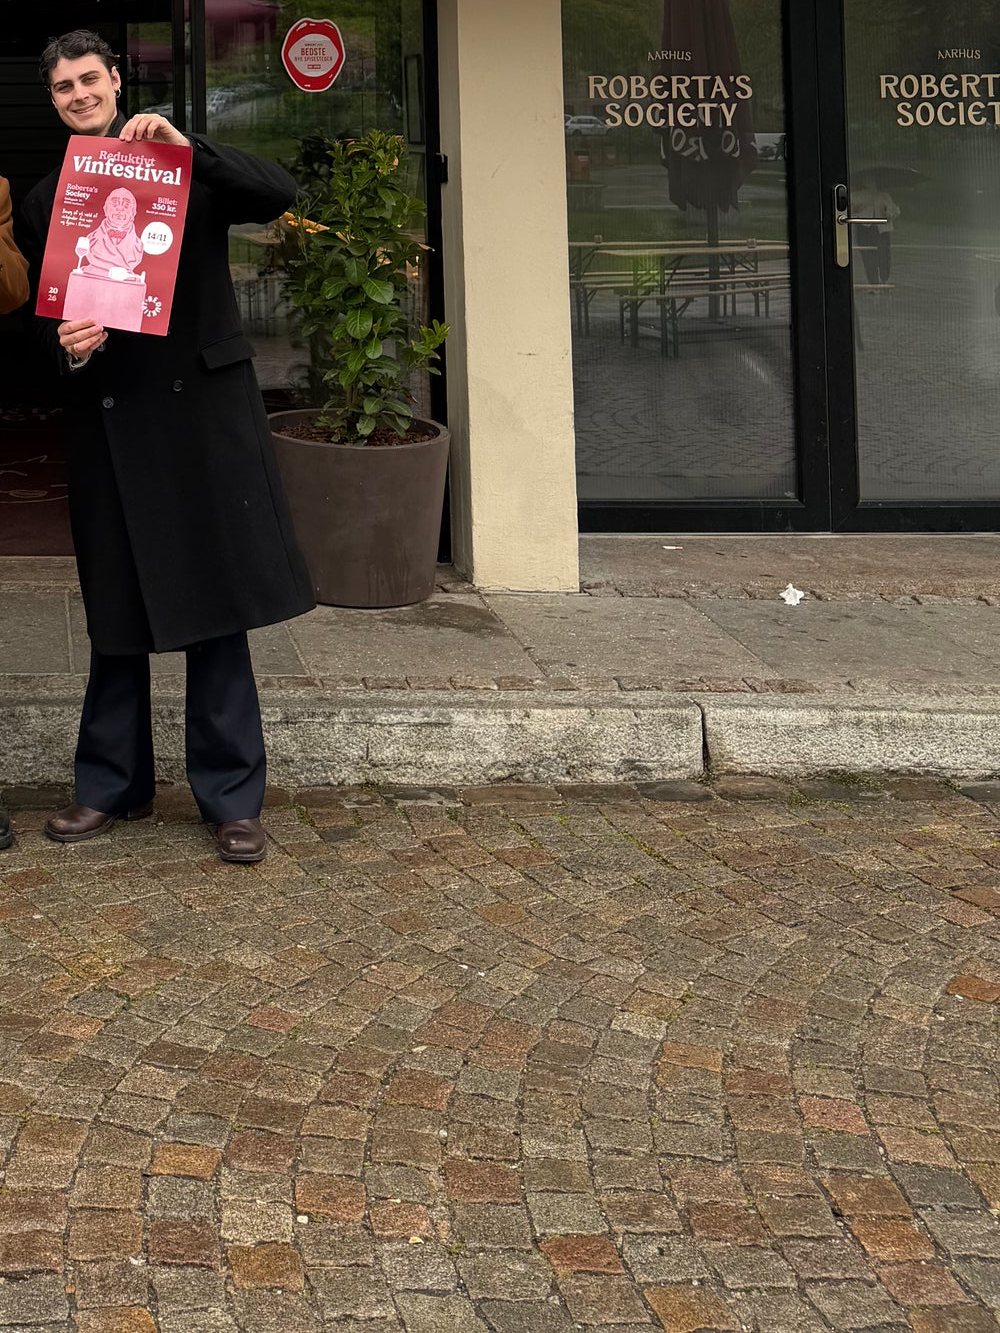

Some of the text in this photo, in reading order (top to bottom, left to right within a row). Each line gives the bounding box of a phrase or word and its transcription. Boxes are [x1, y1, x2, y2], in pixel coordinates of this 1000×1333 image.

[300, 47, 326, 56] BEDSTE
[647, 50, 692, 61] AARHUS
[937, 49, 981, 60] AARHUS
[588, 75, 753, 100] ROBERTA'S
[879, 74, 1000, 98] ROBERT
[605, 102, 738, 127] SOCIETY
[99, 150, 156, 167] Reduktivt
[73, 155, 182, 186] Vinfestival
[66, 183, 99, 193] Roberta's
[65, 189, 91, 200] Society
[151, 202, 177, 213] 350 kr.
[147, 232, 167, 242] 14/11
[48, 286, 59, 295] 20
[47, 294, 57, 302] 26
